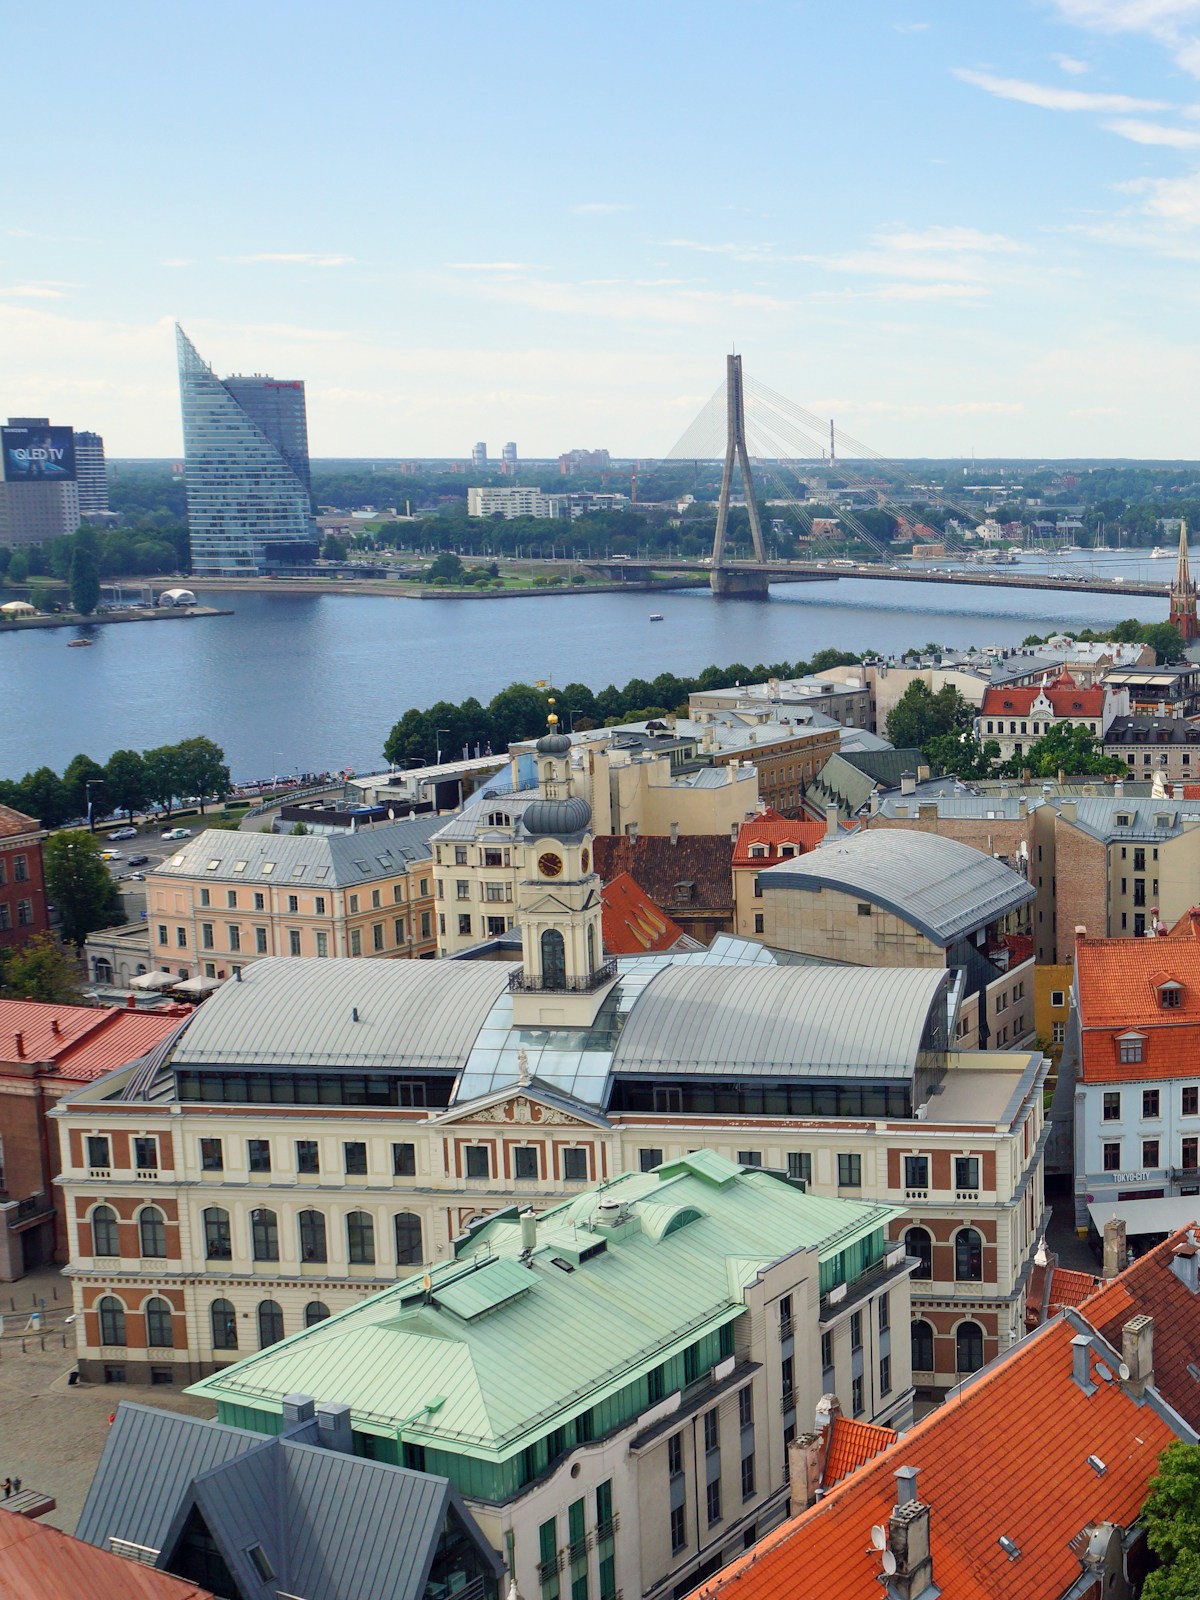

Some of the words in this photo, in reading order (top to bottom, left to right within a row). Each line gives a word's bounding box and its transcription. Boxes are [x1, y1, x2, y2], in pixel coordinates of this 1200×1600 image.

[15, 448, 47, 460] QLED
[48, 448, 64, 460] TV
[1113, 1171, 1150, 1183] TOKYO-CITY
